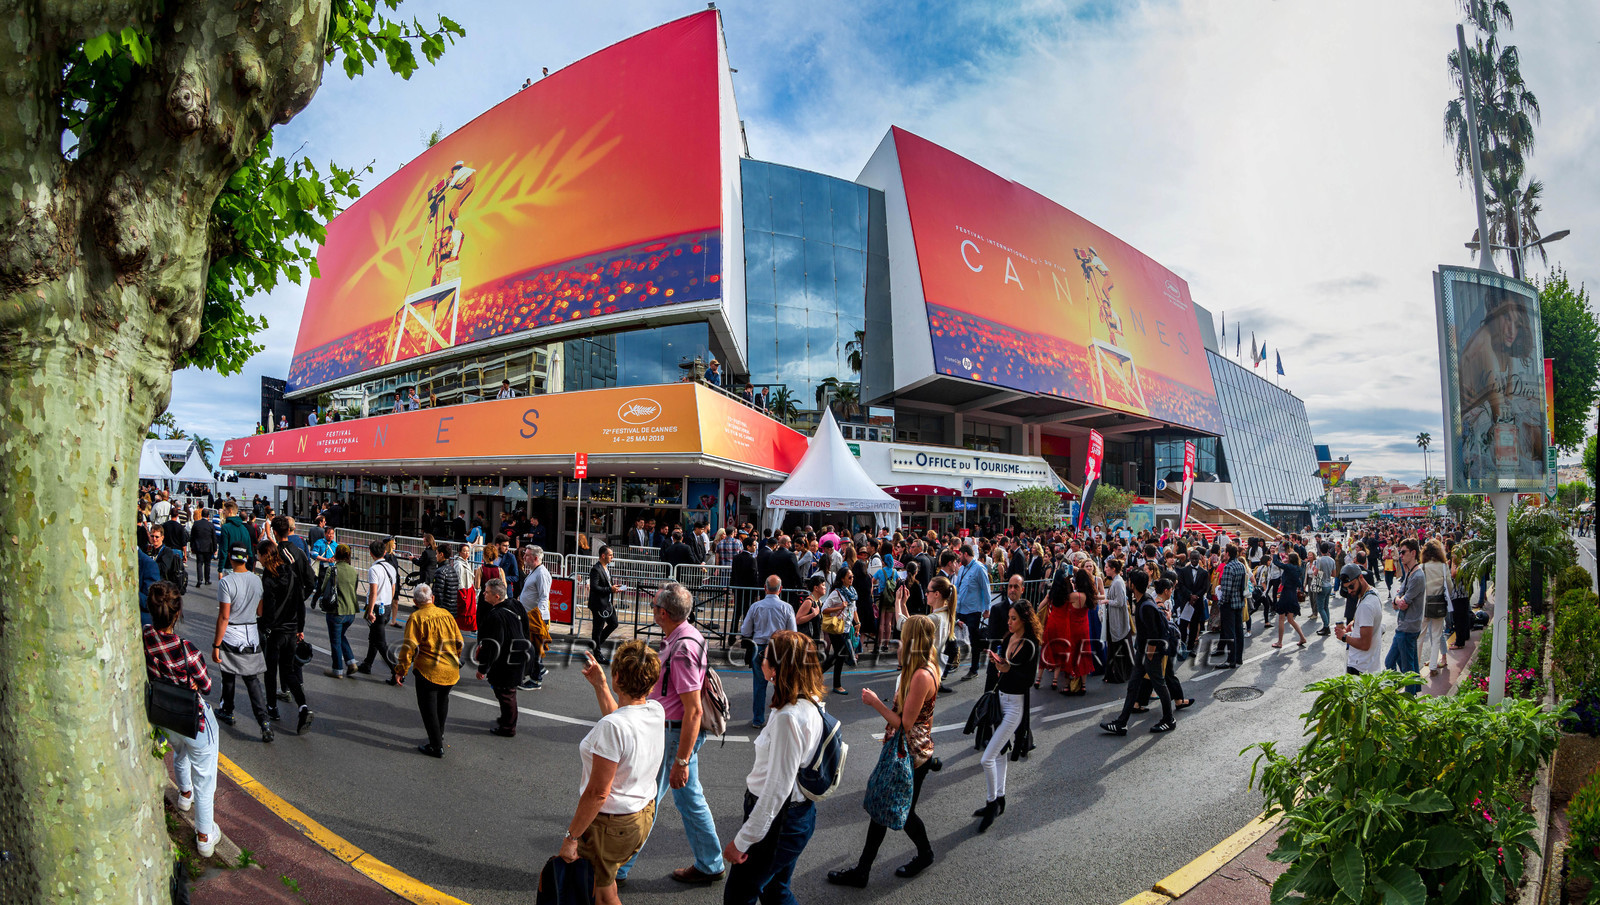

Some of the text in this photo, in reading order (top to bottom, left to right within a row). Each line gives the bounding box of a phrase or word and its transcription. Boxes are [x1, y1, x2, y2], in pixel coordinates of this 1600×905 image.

[955, 225, 984, 241] FESTIVAL
[986, 238, 1029, 261] INTERNATIONAL
[1508, 373, 1540, 399] Dior
[326, 429, 351, 437] FESTIVAL
[612, 427, 640, 435] FESTIVAL
[651, 425, 678, 433] CANNES
[316, 437, 359, 446] INTERNATIONAL
[648, 434, 665, 442] 2019
[850, 502, 897, 510] REGISTRATION
